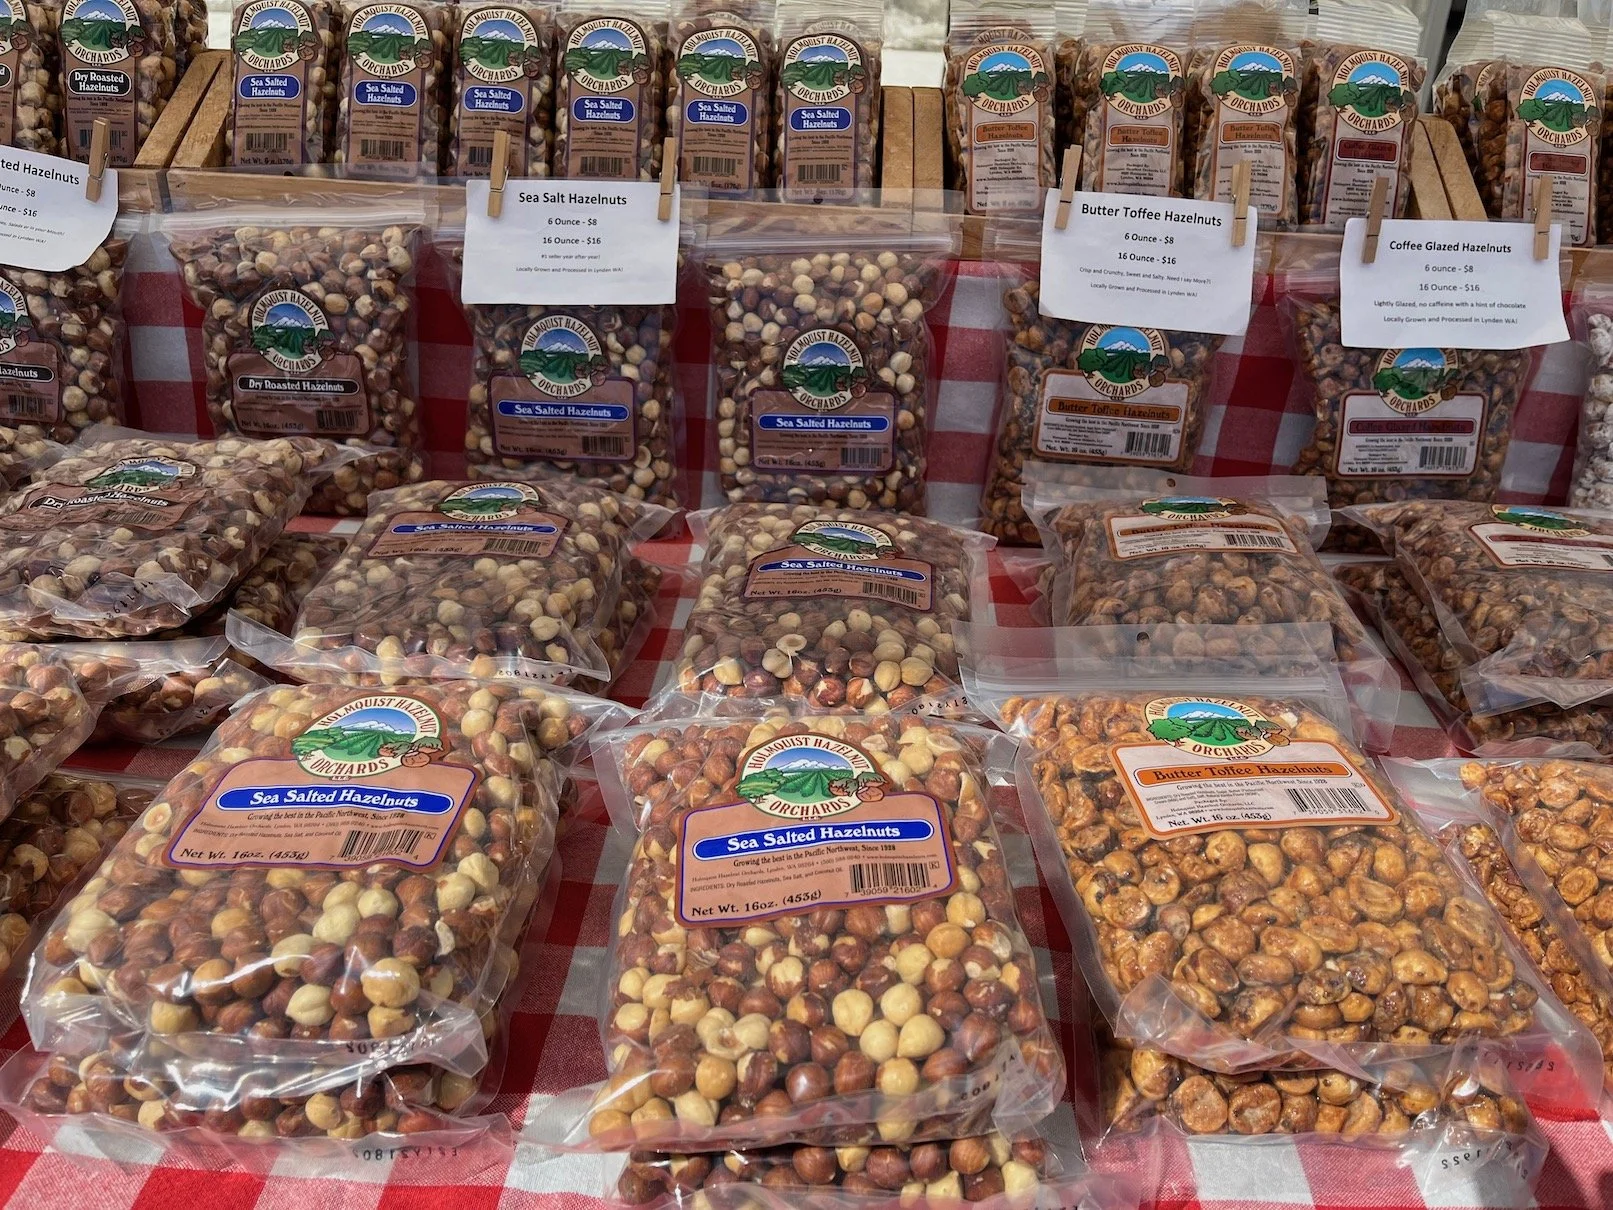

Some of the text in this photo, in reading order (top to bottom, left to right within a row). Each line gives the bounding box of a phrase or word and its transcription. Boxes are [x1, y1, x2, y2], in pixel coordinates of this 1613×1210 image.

[353, 6, 426, 36] HOLMQUIST HAZELNUT
[362, 61, 410, 76] ORCHARDS
[1337, 52, 1408, 86] HOLMQUIST HAZELNUT
[74, 72, 124, 83] Dry Roasted
[250, 78, 288, 86] Sea Salted
[79, 82, 119, 93] Hazelnuts
[252, 87, 286, 97] Hazelnuts
[366, 84, 404, 94] Sea Salted
[474, 88, 512, 100] Sea Salted
[367, 94, 402, 104] Hazelnuts
[475, 99, 509, 110] Hazelnuts
[584, 100, 622, 110] Sea Salted
[698, 102, 736, 113] Sea Salted
[586, 110, 620, 120] Hazelnuts
[699, 112, 734, 122] Hazelnuts
[801, 110, 839, 120] Sea Salted
[803, 119, 838, 128] Hazelnuts
[1348, 114, 1396, 130] ORCHARDS
[23, 163, 80, 186] Hazelnuts
[26, 188, 36, 198] $8
[519, 192, 627, 206] Sea Salt Hazelnuts
[0, 204, 38, 218] unce $16
[1082, 203, 1222, 227] Butter Toffee Hazelnuts
[548, 218, 598, 226] 6 Ounce $8
[543, 236, 602, 246] 16 Ounce $16
[1124, 232, 1174, 245] 6 Ounce $8
[1390, 240, 1512, 254] Coffee Glazed Hazelnuts
[1118, 252, 1177, 265] 16 Ounce $16
[1080, 266, 1092, 274] Crisp
[1103, 268, 1126, 277] Crunchy,
[1184, 276, 1192, 284] say
[1424, 264, 1430, 272] 6
[1464, 264, 1474, 274] $8
[1419, 283, 1480, 292] 16 Ounce $16
[1374, 300, 1394, 308] Lightly
[1395, 300, 1418, 308] Glazed,
[1428, 300, 1454, 308] caffeine
[1496, 301, 1526, 309] chocolate
[1384, 316, 1404, 324] Locally
[1442, 316, 1472, 324] Processed
[248, 378, 344, 392] Dry Roasted Hazelnuts
[514, 404, 612, 418] Sea Salted Hazelnuts
[1058, 401, 1170, 420] Butter Toffee Hazelnuts
[776, 418, 872, 429] Sea Salted Hazelnuts
[414, 523, 534, 532] Sea Salted Hazelnuts
[780, 560, 903, 577] Sea Salted Hazelnuts
[318, 698, 436, 734] HOLMQUIST HAZELNUT
[748, 736, 870, 770] HOLMQUIST HAZELNUT
[1192, 741, 1266, 757] ORCHARDS
[310, 758, 389, 775] ORCHARDS
[1153, 765, 1333, 781] Butter Toffee Hazelnuts
[250, 790, 418, 808] Sea Salted Hazelnuts
[770, 798, 851, 816] ORCHARDS
[248, 812, 272, 821] Growing
[274, 812, 282, 820] the
[284, 812, 297, 820] best
[298, 812, 304, 820] in
[305, 812, 314, 820] the
[316, 811, 336, 820] Pacific
[337, 810, 369, 820] Northwest,
[371, 812, 388, 820] Since
[1168, 820, 1190, 828] Net.
[1191, 816, 1210, 824] Wt.
[1240, 812, 1272, 821] (453g)
[727, 824, 901, 852] Sea Salted Hazelnuts
[180, 848, 310, 860] Net Wt. 16oz. (453g)
[734, 859, 760, 868] Growing
[761, 856, 771, 865] the
[772, 855, 785, 863] best
[794, 852, 804, 860] the
[804, 848, 825, 858] Pacific
[826, 845, 860, 855] Northwest,
[862, 844, 879, 852] Since
[860, 887, 888, 897] 39059
[692, 888, 822, 917] Net Wt. 16oz. (453g)
